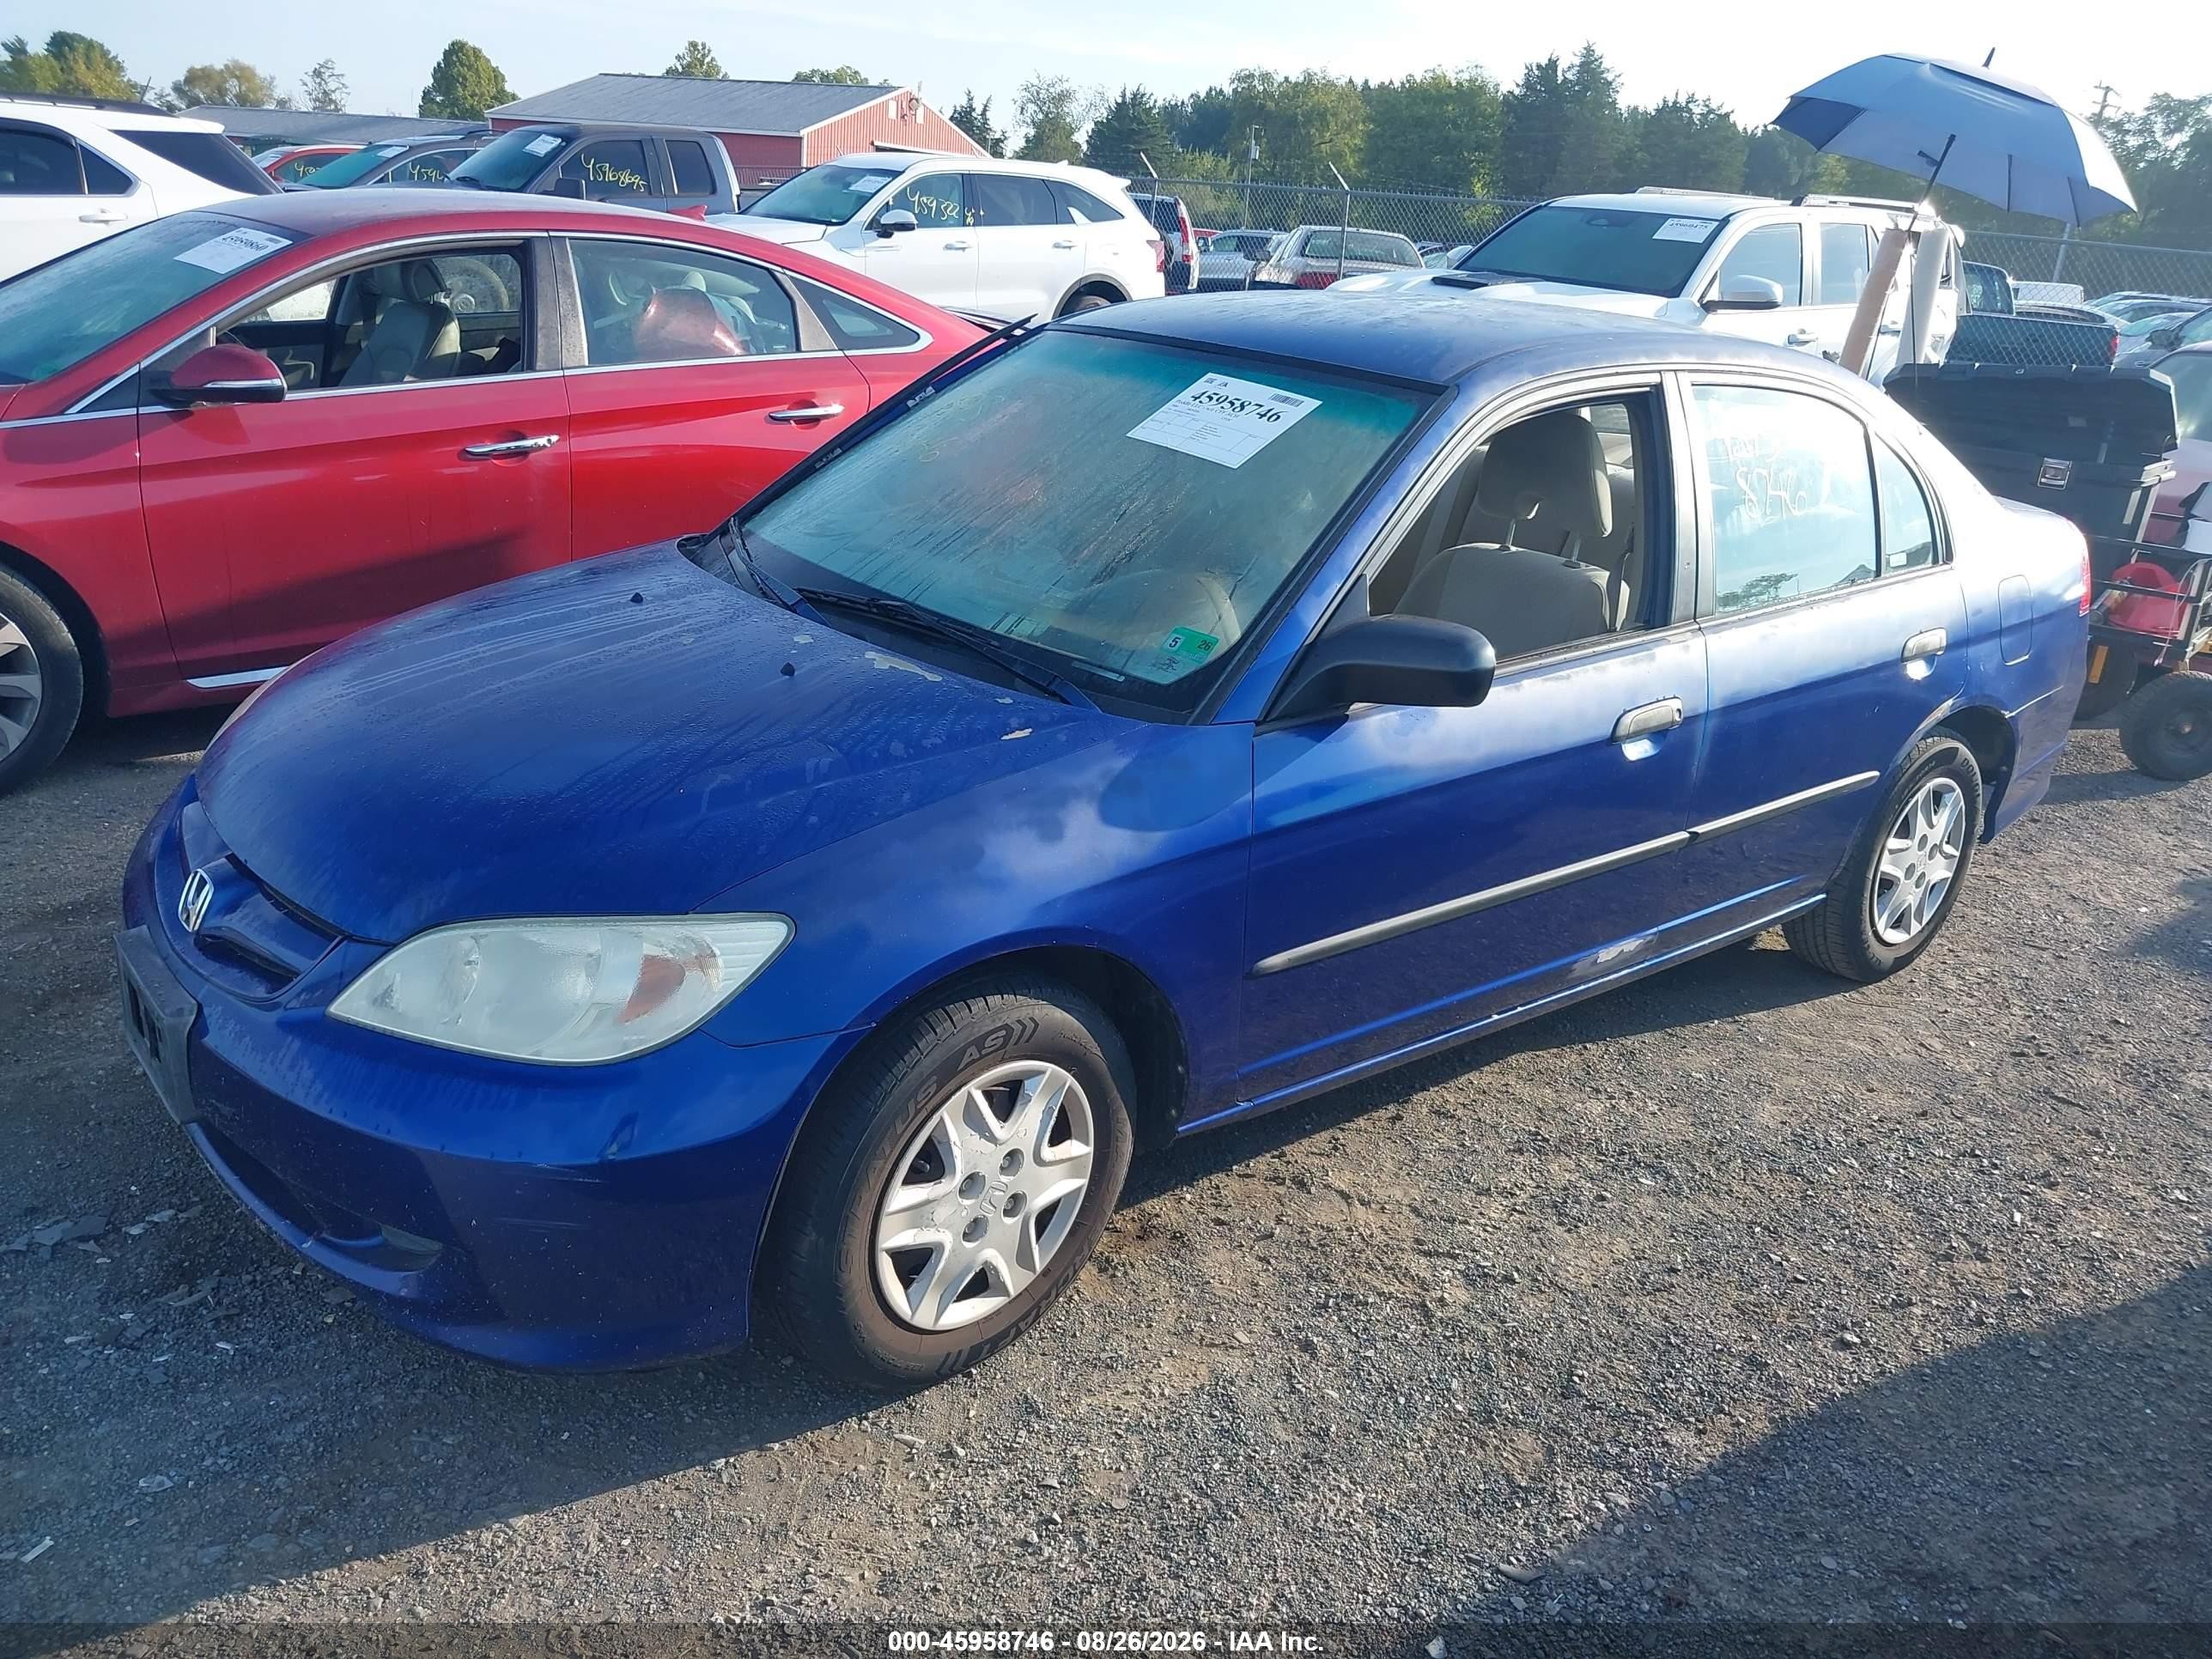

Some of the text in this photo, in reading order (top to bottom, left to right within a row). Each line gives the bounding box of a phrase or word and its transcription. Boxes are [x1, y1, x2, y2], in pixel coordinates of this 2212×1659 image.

[580, 153, 649, 192] 45968695
[1190, 390, 1289, 422] 45958746
[1169, 636, 1214, 652] 5 26
[957, 1029, 1007, 1071] AS
